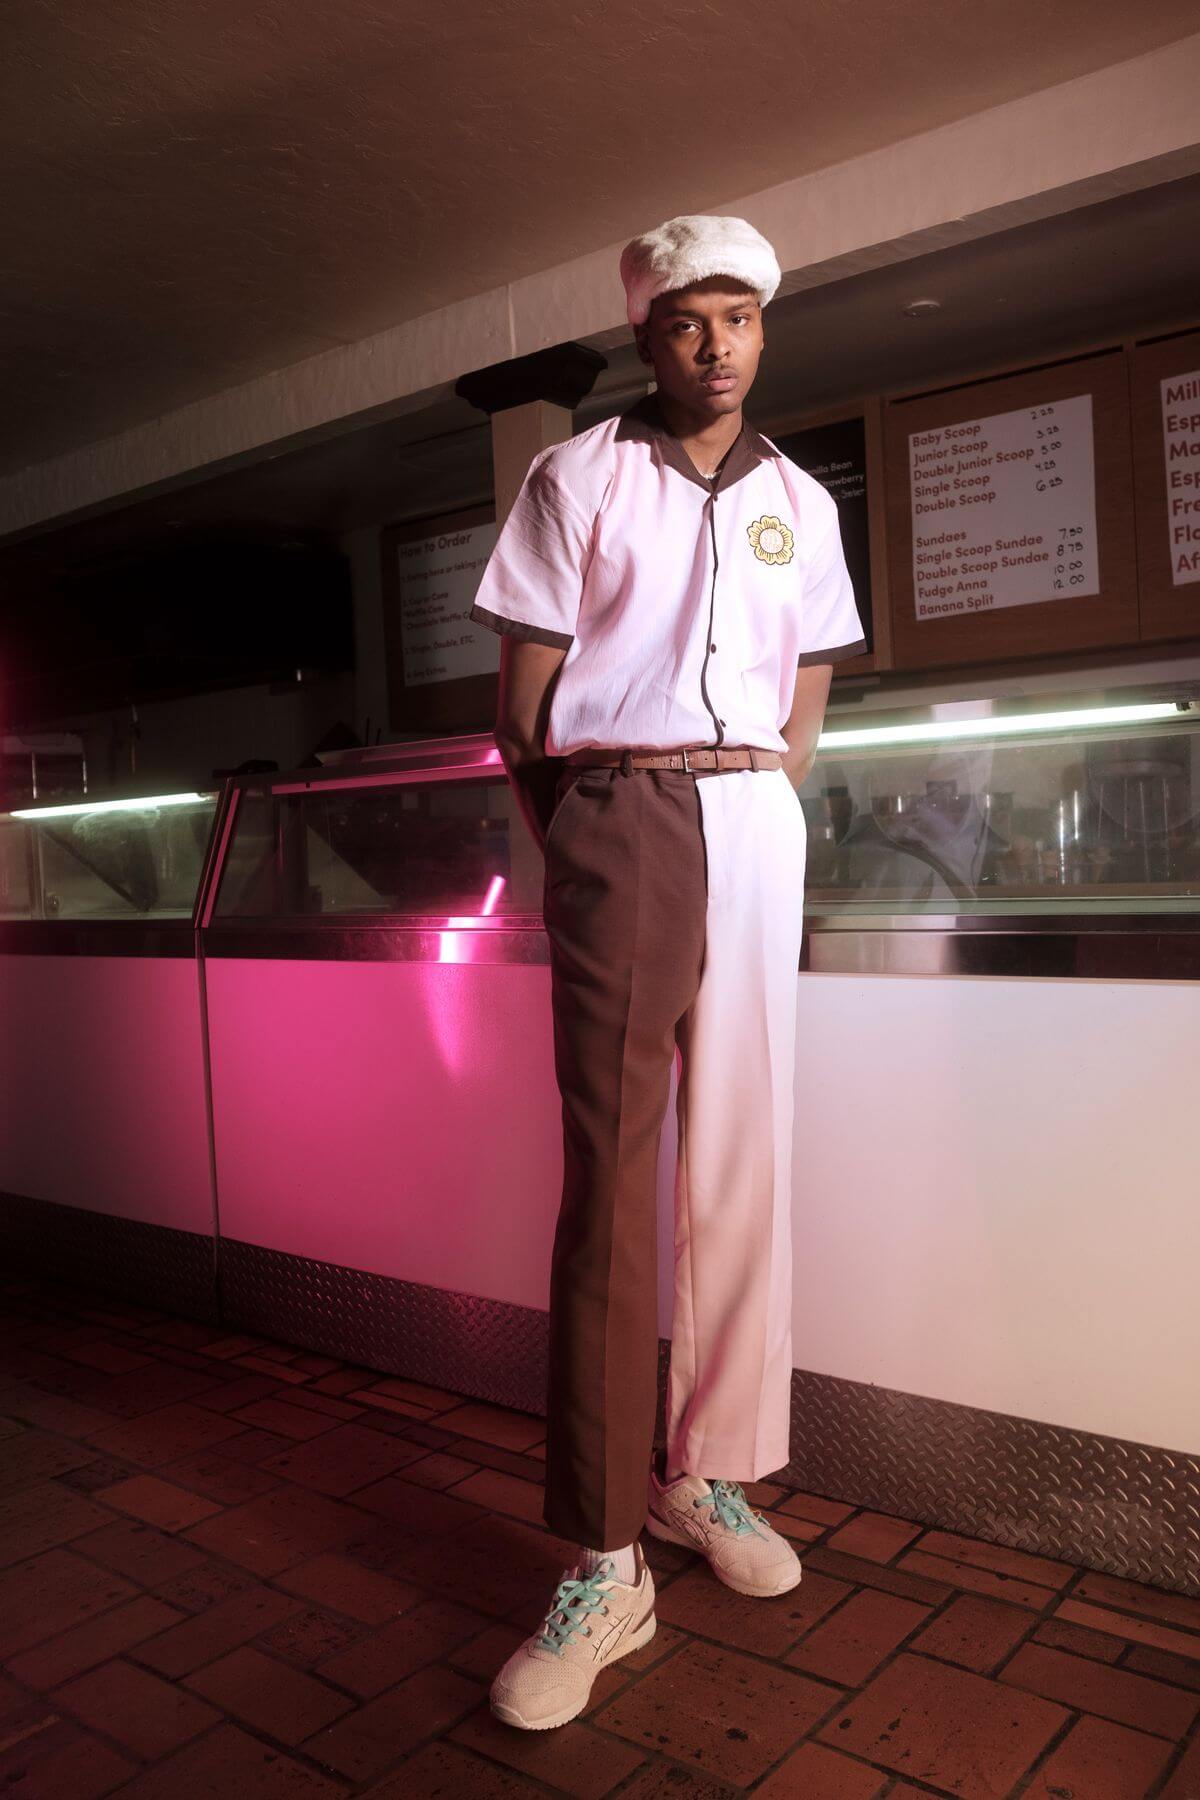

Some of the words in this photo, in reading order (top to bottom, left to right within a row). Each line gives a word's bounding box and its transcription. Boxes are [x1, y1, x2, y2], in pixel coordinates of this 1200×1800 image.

[912, 432, 942, 448] Baby
[944, 424, 981, 440] Scoop
[914, 450, 949, 467] Junior
[951, 440, 988, 456] Scoop
[914, 464, 954, 481] Double
[956, 457, 994, 475] Junior
[996, 447, 1035, 464] Scoop
[915, 483, 951, 498] Single
[953, 474, 991, 490] Scoop
[916, 498, 956, 515] Double
[959, 491, 996, 506] Scoop
[424, 541, 436, 554] to
[437, 534, 472, 550] Order
[916, 530, 967, 548] Sundaes
[916, 549, 953, 567] Single
[955, 543, 993, 558] Scoop
[995, 534, 1043, 552] Sundae
[917, 565, 958, 582] Double
[961, 560, 999, 575] Scoop
[1001, 551, 1049, 567] Sundae
[918, 584, 953, 599] Fudge
[956, 579, 987, 593] Anna
[919, 600, 964, 616] Banana
[967, 594, 994, 609] Split
